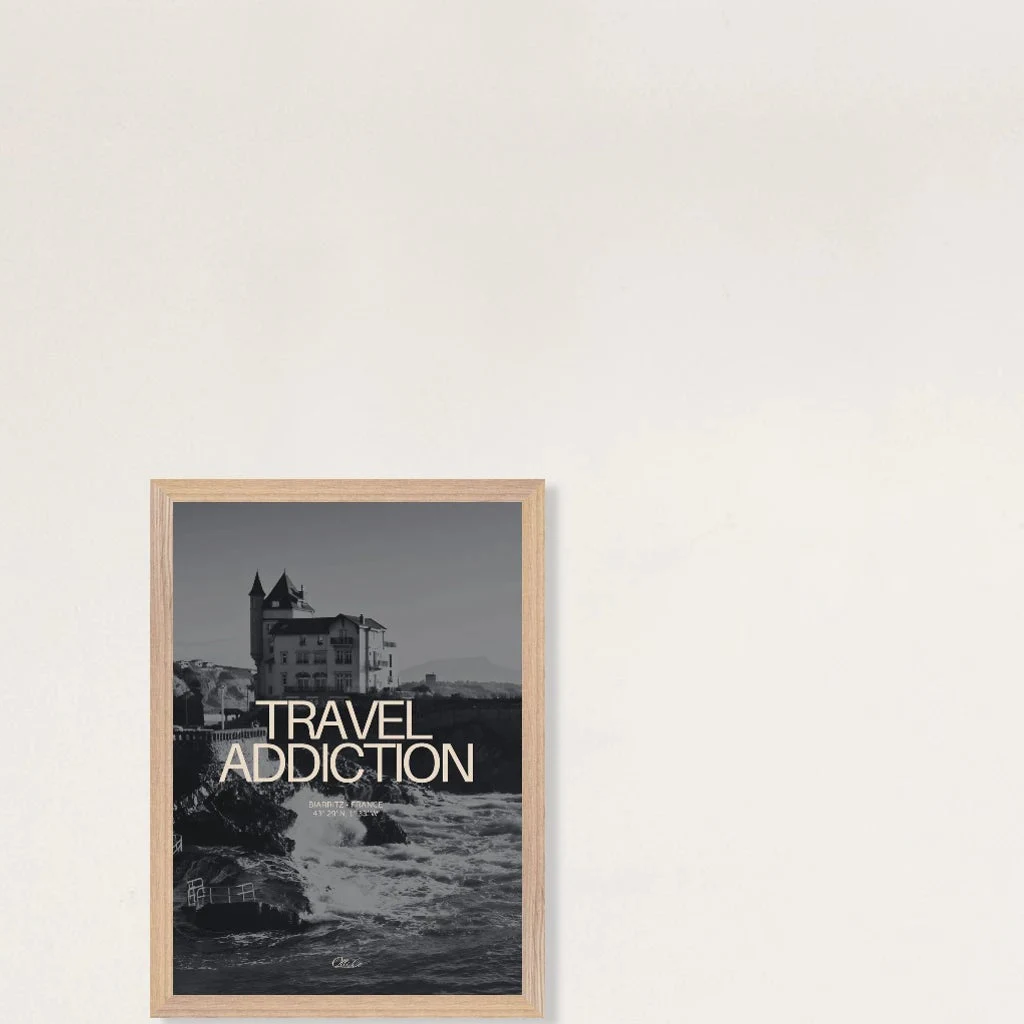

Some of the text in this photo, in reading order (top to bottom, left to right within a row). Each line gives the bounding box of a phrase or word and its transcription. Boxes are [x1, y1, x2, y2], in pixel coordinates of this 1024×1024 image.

[255, 699, 433, 740] TRAVEL
[219, 742, 474, 783] ADDICTION
[350, 800, 384, 809] FRANCE
